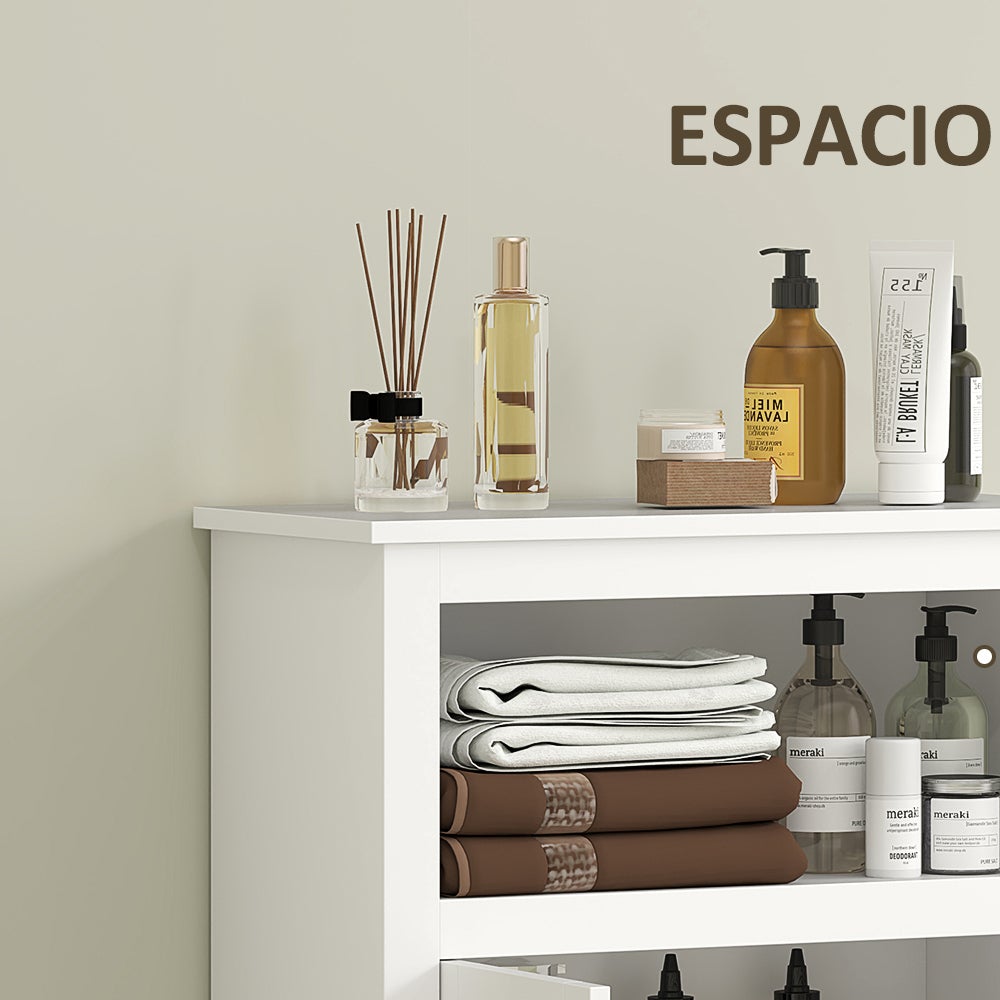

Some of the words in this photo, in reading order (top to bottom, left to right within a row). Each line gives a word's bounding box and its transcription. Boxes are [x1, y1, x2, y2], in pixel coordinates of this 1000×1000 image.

[789, 748, 825, 757] meraki
[920, 750, 938, 759] raki
[933, 810, 970, 819] meraki
